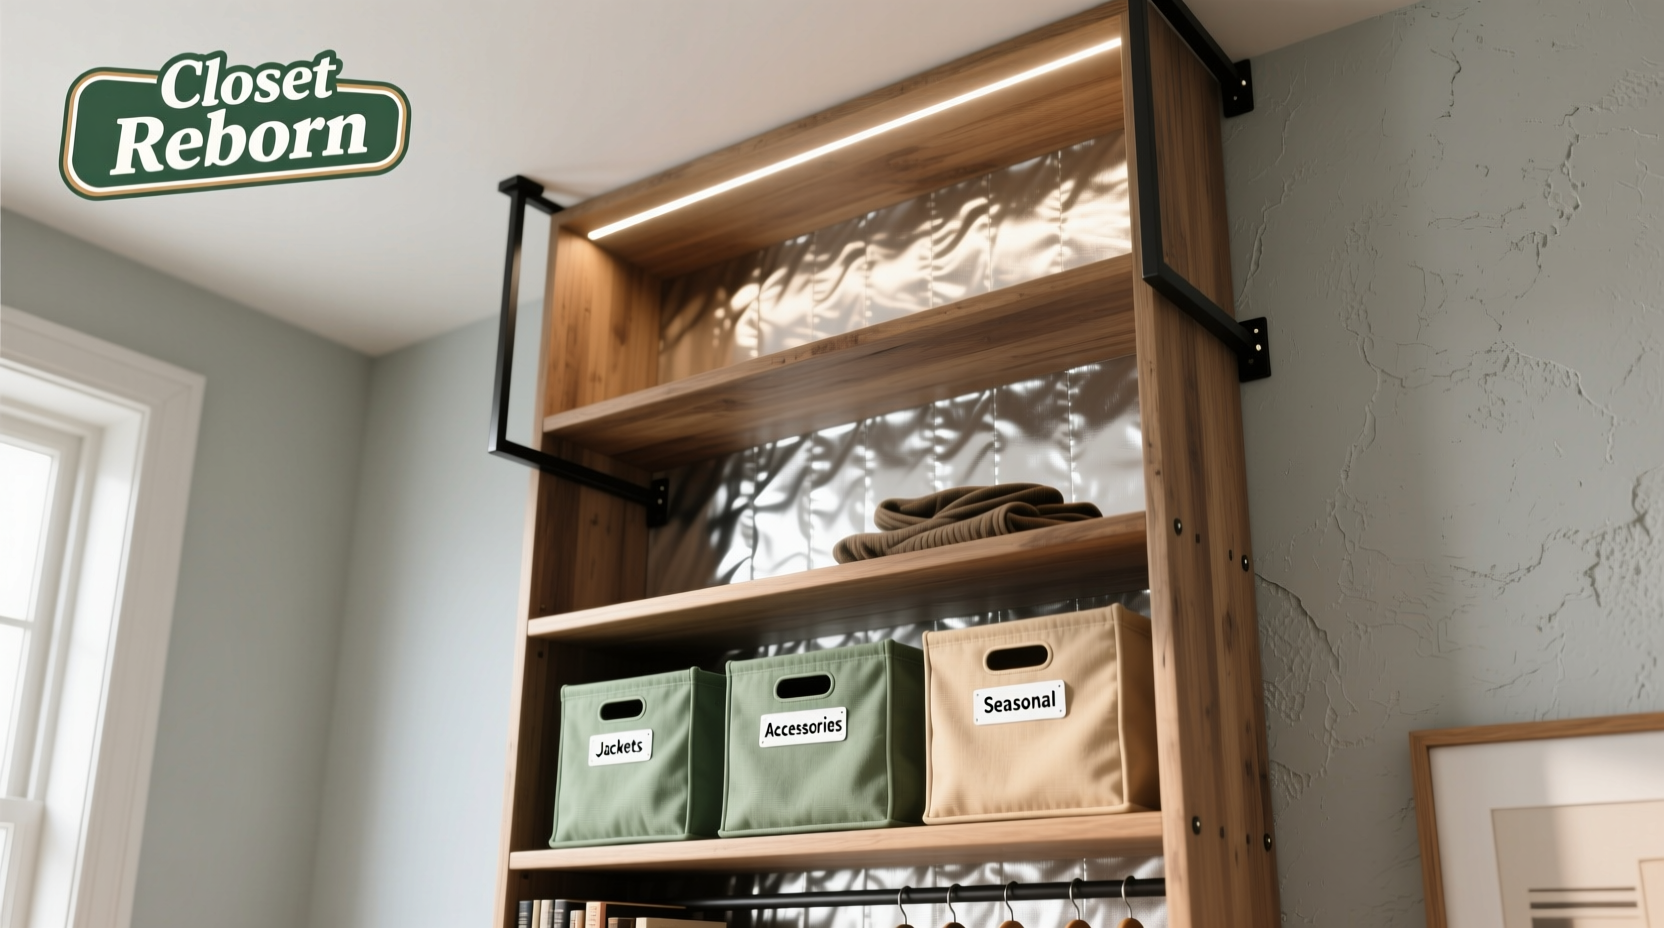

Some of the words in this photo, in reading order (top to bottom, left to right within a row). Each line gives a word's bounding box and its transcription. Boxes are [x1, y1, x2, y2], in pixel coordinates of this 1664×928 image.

[983, 690, 1055, 714] Seasonal
[764, 716, 843, 738] Accessories
[595, 739, 643, 755] Jackets
